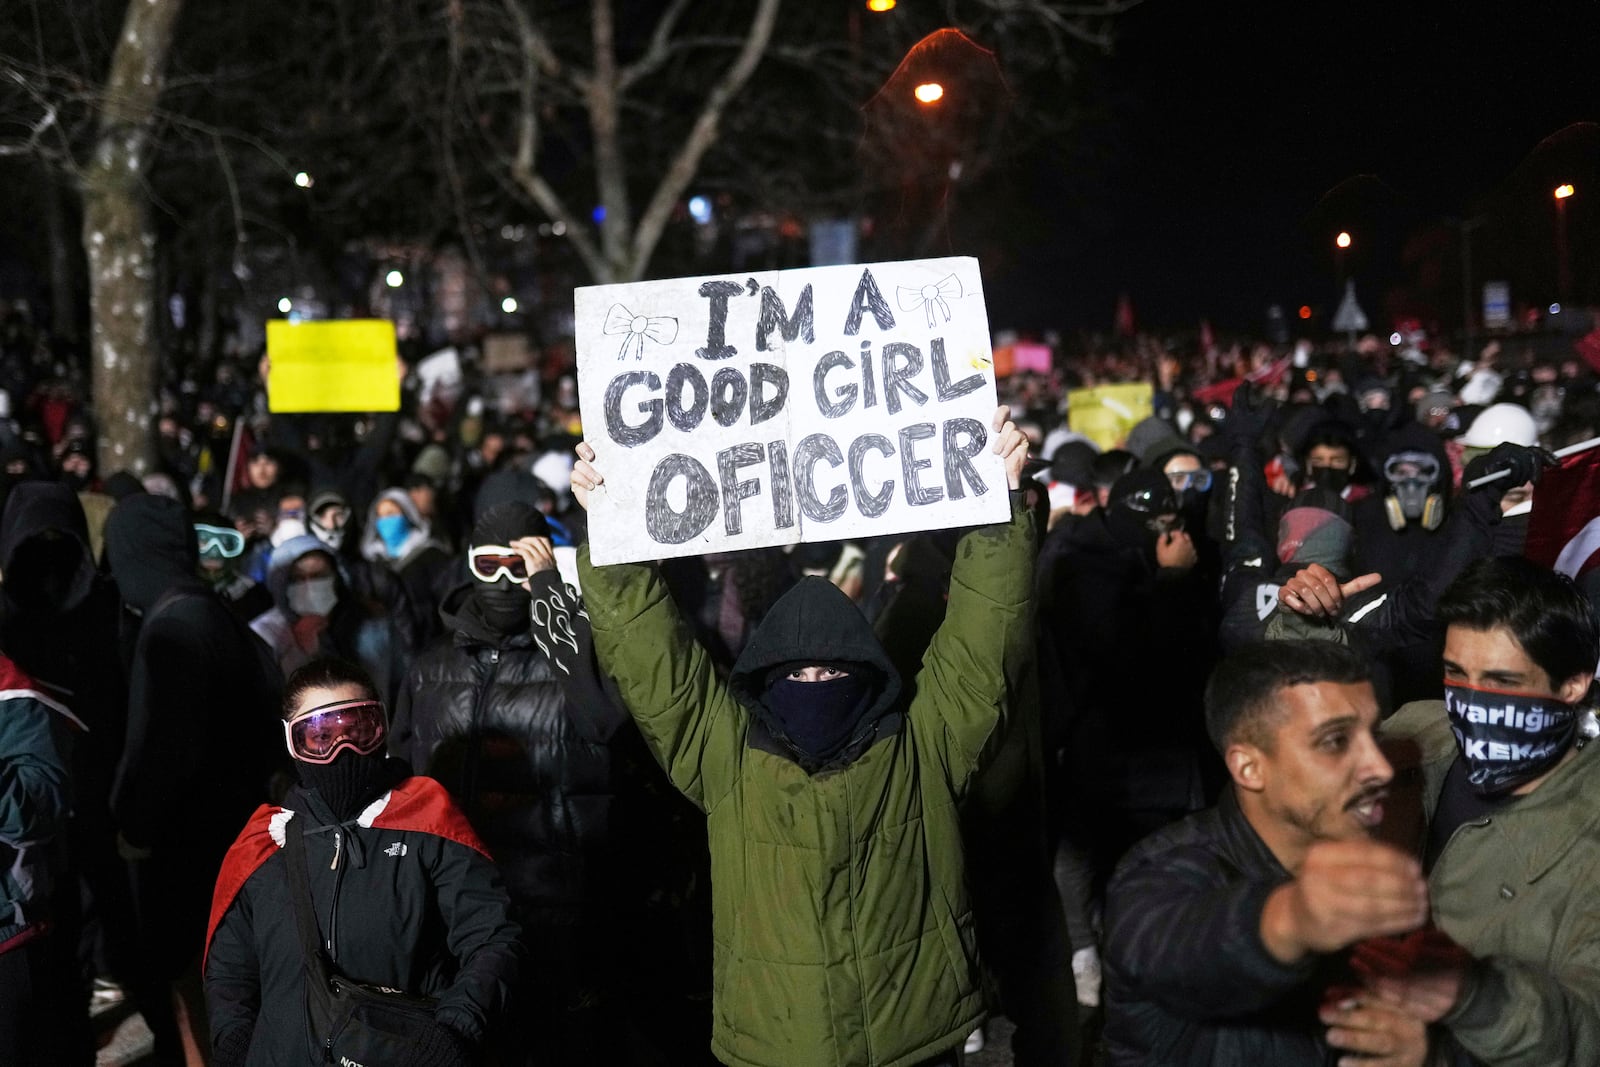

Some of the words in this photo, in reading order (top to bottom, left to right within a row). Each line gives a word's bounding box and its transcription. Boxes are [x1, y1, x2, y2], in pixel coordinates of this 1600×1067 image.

[695, 277, 816, 361] I'M
[843, 267, 896, 336] A
[603, 362, 790, 448] GOOD
[645, 417, 989, 545] OFICCER
